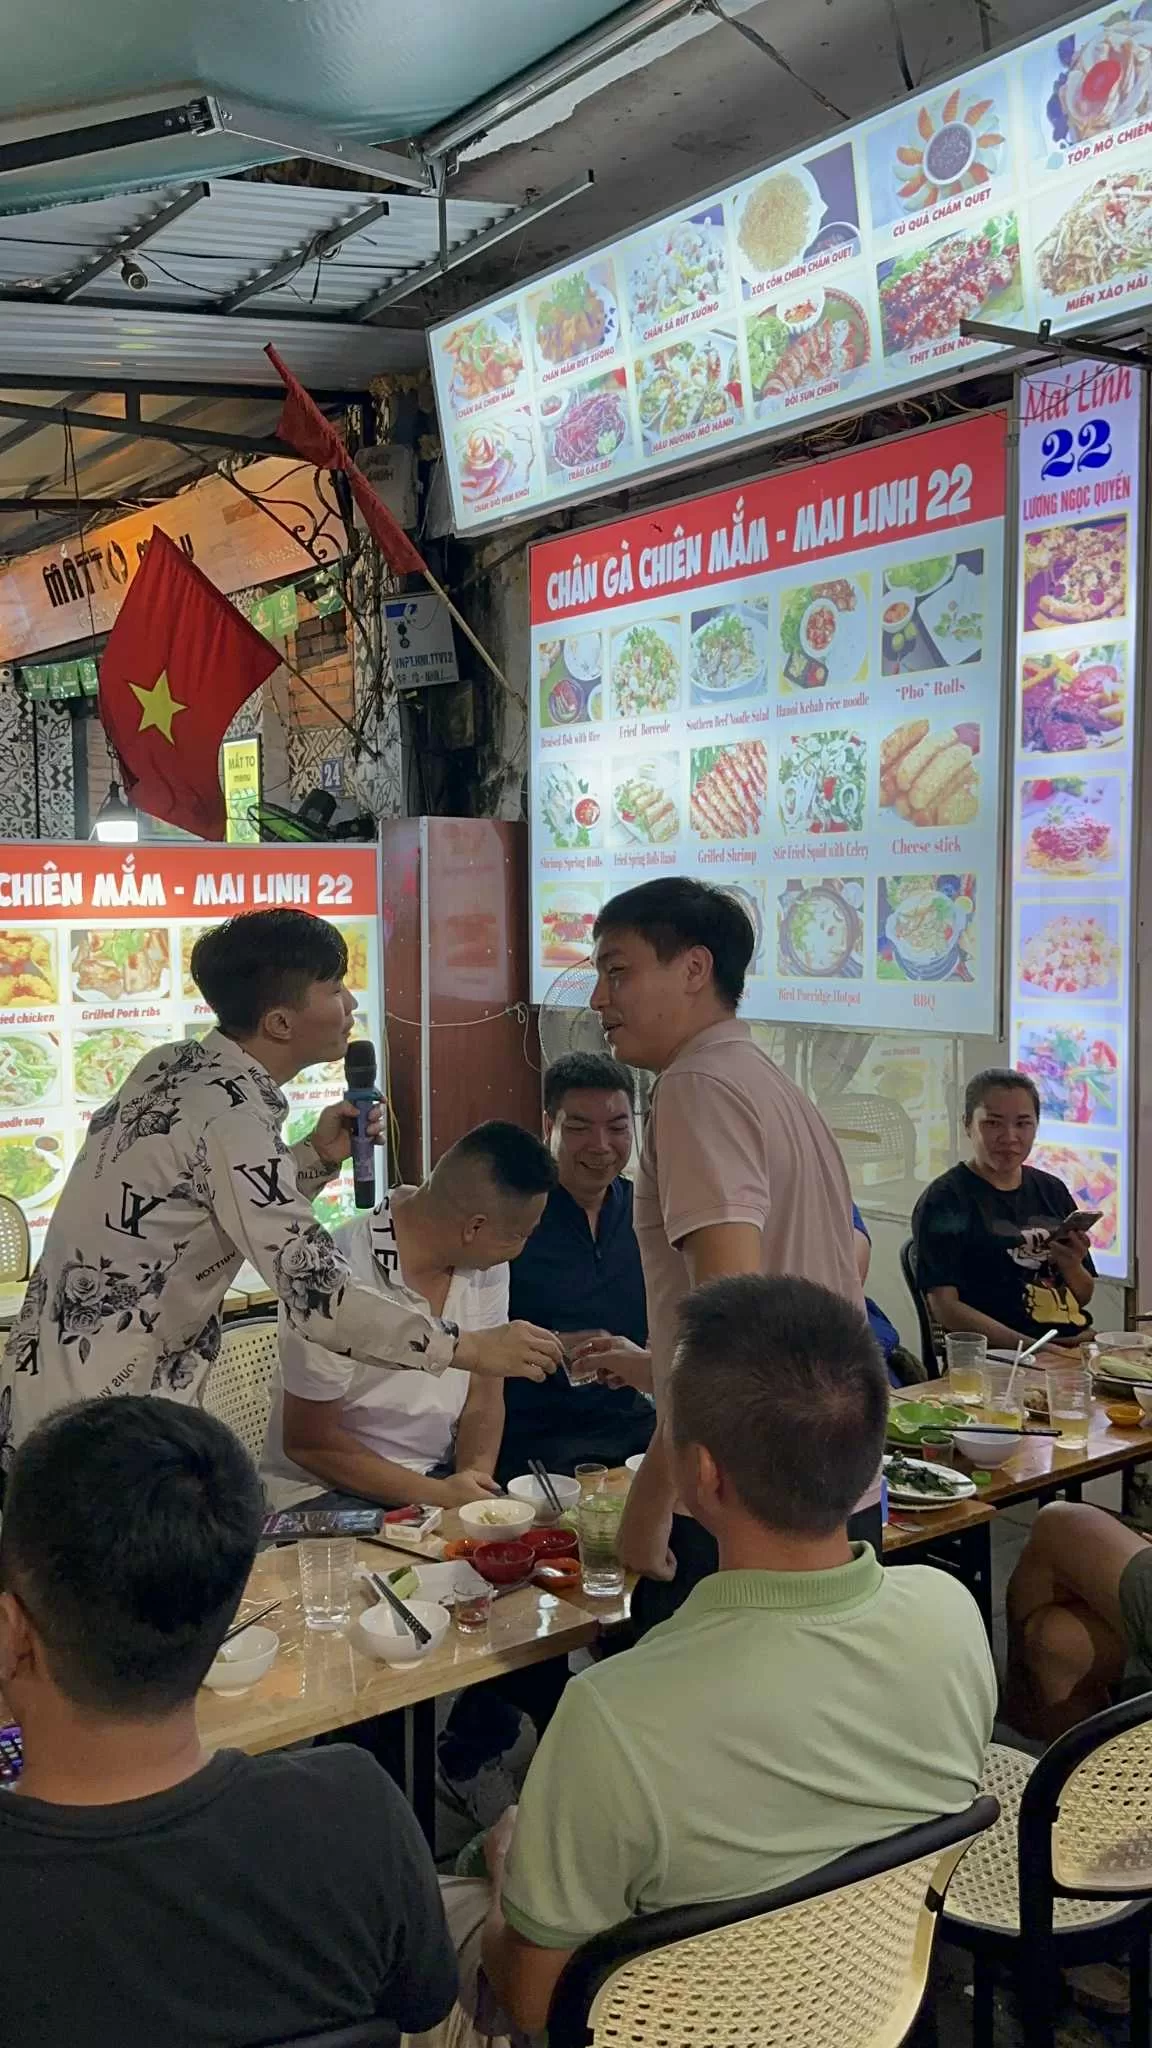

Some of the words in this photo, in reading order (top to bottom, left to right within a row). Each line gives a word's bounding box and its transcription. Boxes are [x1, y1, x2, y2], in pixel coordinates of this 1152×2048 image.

[1024, 374, 1070, 427] Mai
[1077, 364, 1133, 413] Linh
[1041, 419, 1113, 481] 22
[1060, 484, 1091, 514] NGỌC
[547, 553, 598, 611] CHÂN
[603, 541, 634, 599] GÀ
[638, 524, 702, 587] CHIÊN
[708, 496, 769, 574] MẮM
[793, 500, 845, 553] MAI
[853, 475, 919, 538] LINH
[925, 463, 973, 521] 22
[934, 677, 966, 696] Rolls
[324, 763, 341, 787] 24
[891, 838, 929, 855] Cheese
[934, 835, 962, 853] stick
[0, 860, 83, 906] CHIÊN
[91, 853, 166, 906] MẮM
[193, 873, 245, 905] MAI
[253, 873, 310, 905] LINH
[316, 874, 354, 905] 22
[81, 1009, 115, 1020] Grilled
[116, 1007, 140, 1019] Pork
[141, 1006, 161, 1017] ribs
[912, 993, 936, 1011] BBQ
[0, 1012, 16, 1024] ied
[17, 1011, 55, 1024] chicken
[24, 1117, 45, 1128] soup
